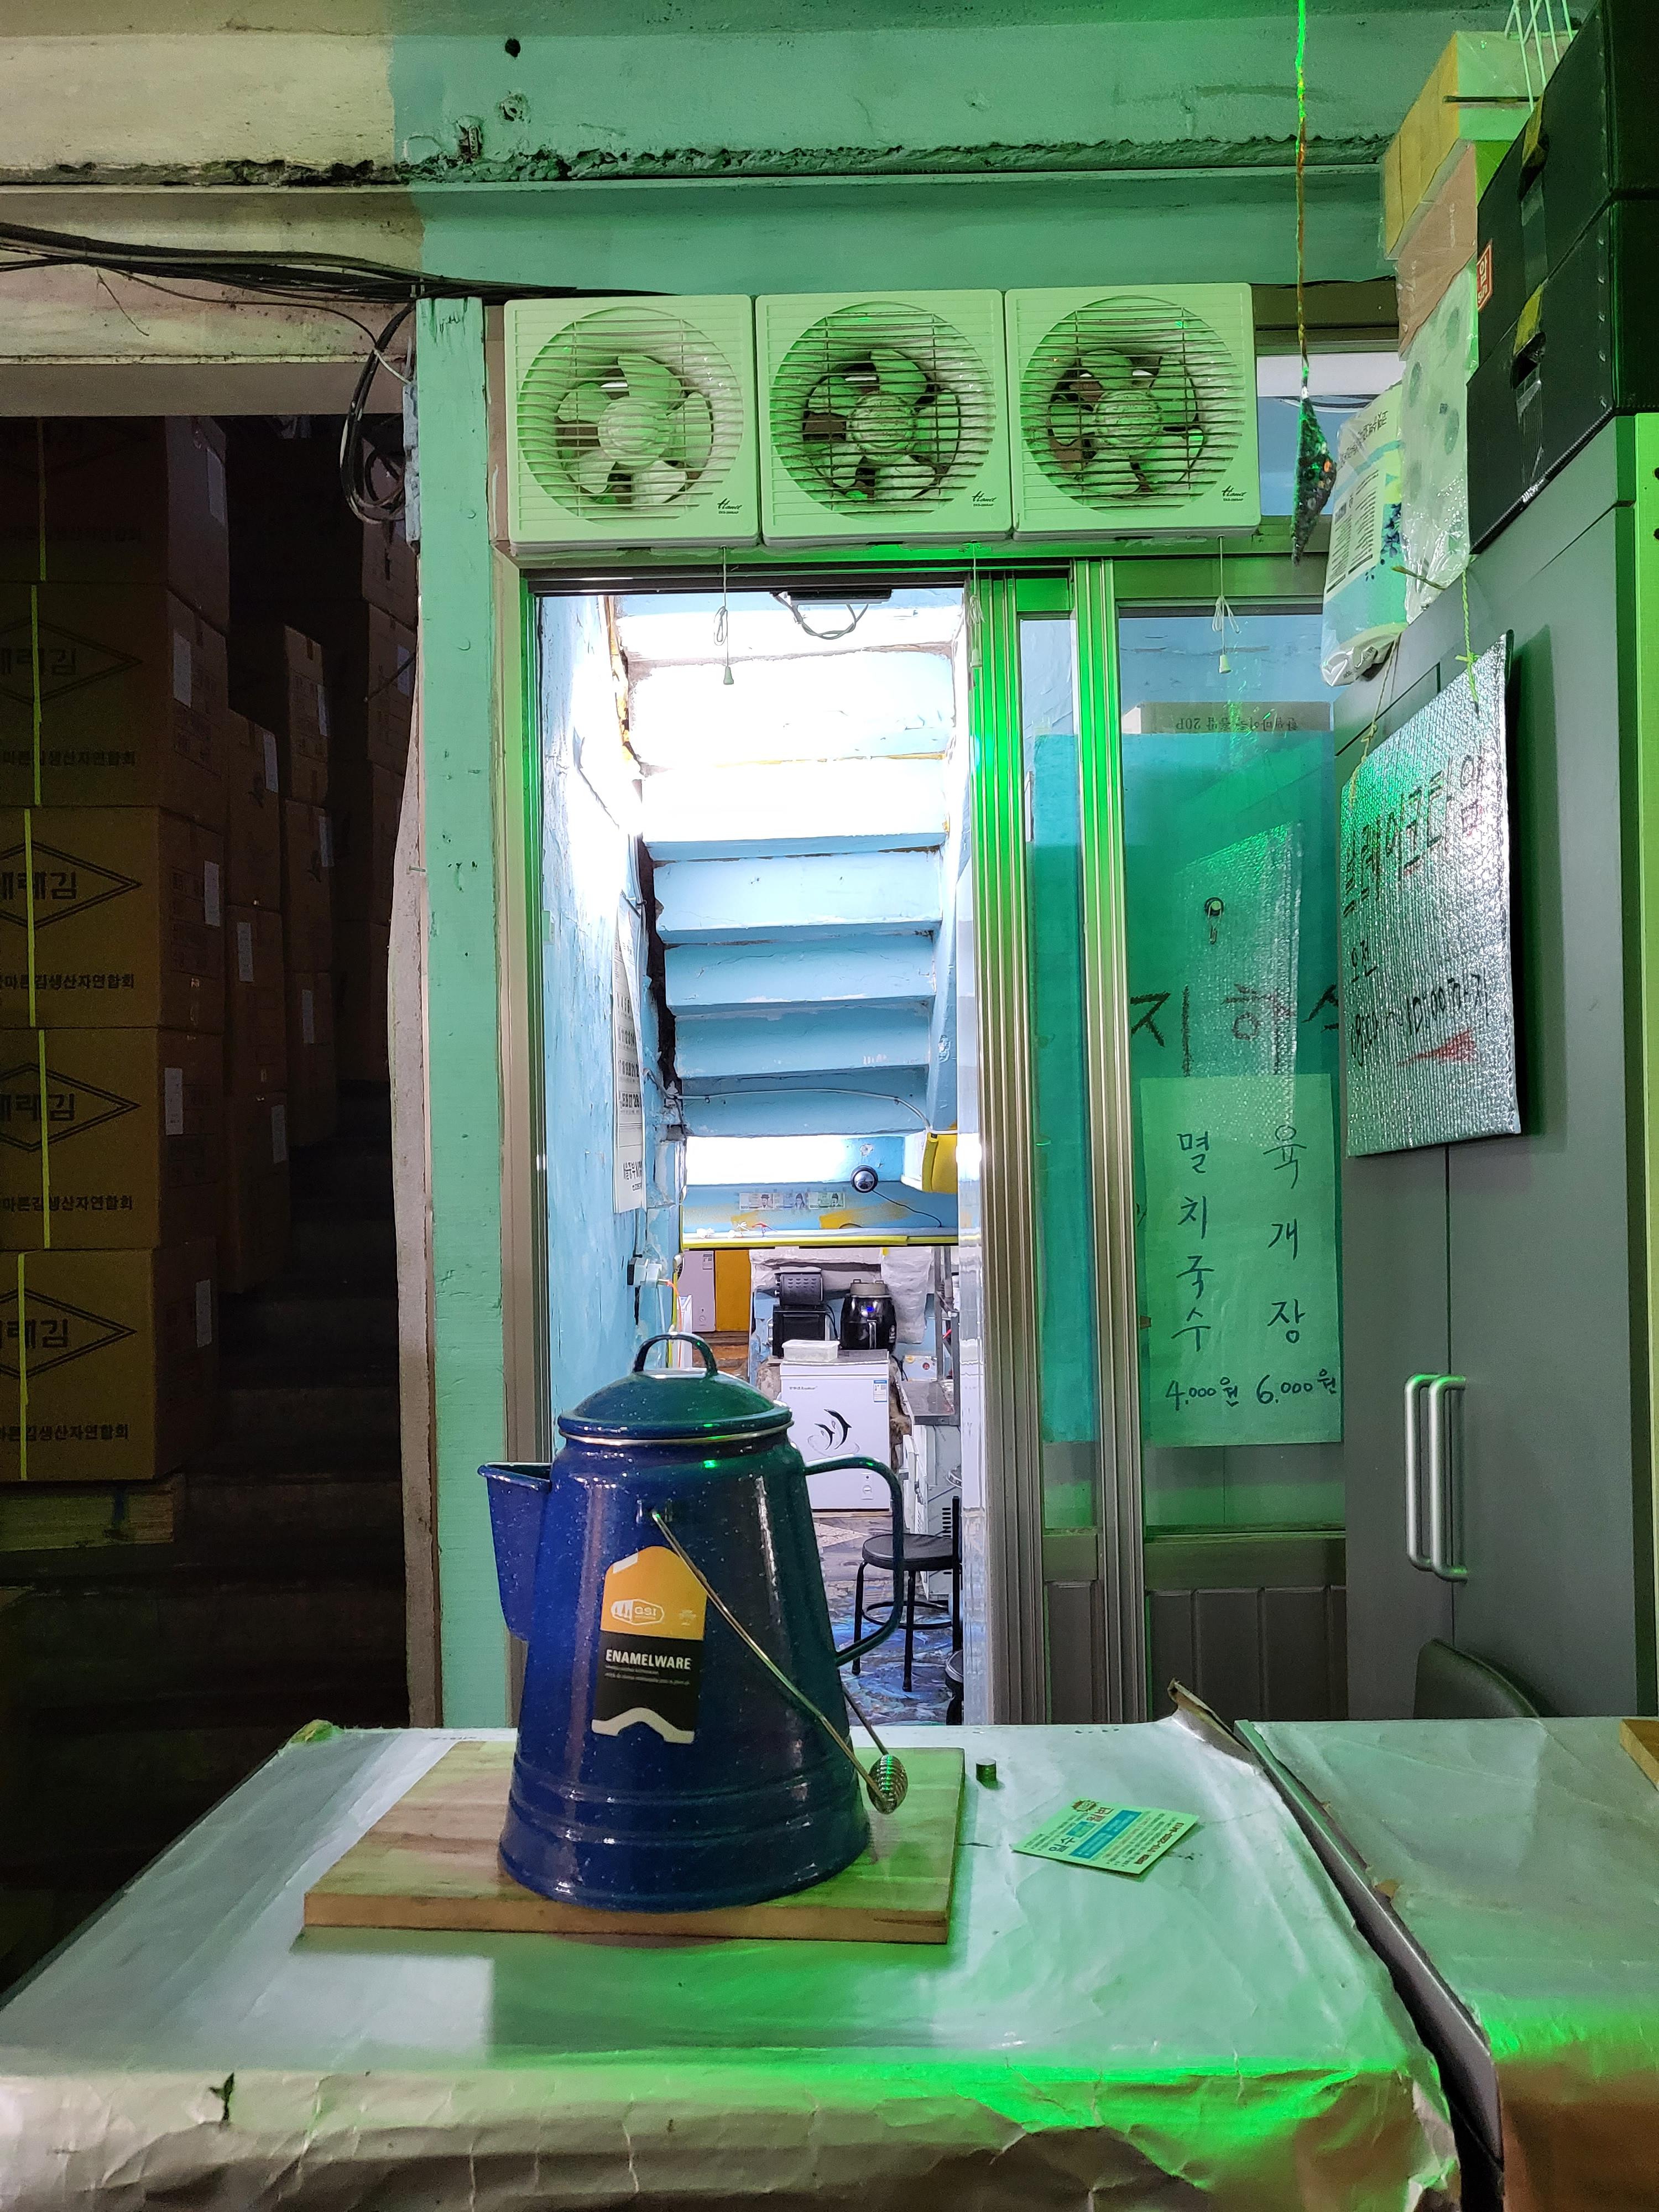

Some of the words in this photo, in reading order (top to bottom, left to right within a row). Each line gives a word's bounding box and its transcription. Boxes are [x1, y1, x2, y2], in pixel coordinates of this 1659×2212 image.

[1175, 717, 1201, 730] 20P
[1351, 936, 1378, 983] 오전
[1170, 1131, 1215, 1353] 멸치국수
[1262, 1124, 1308, 1344] 육개장
[0, 1318, 69, 1348] 래김
[605, 1648, 692, 1670] ENAMELWARE
[1048, 1835, 1076, 1853] 일수
